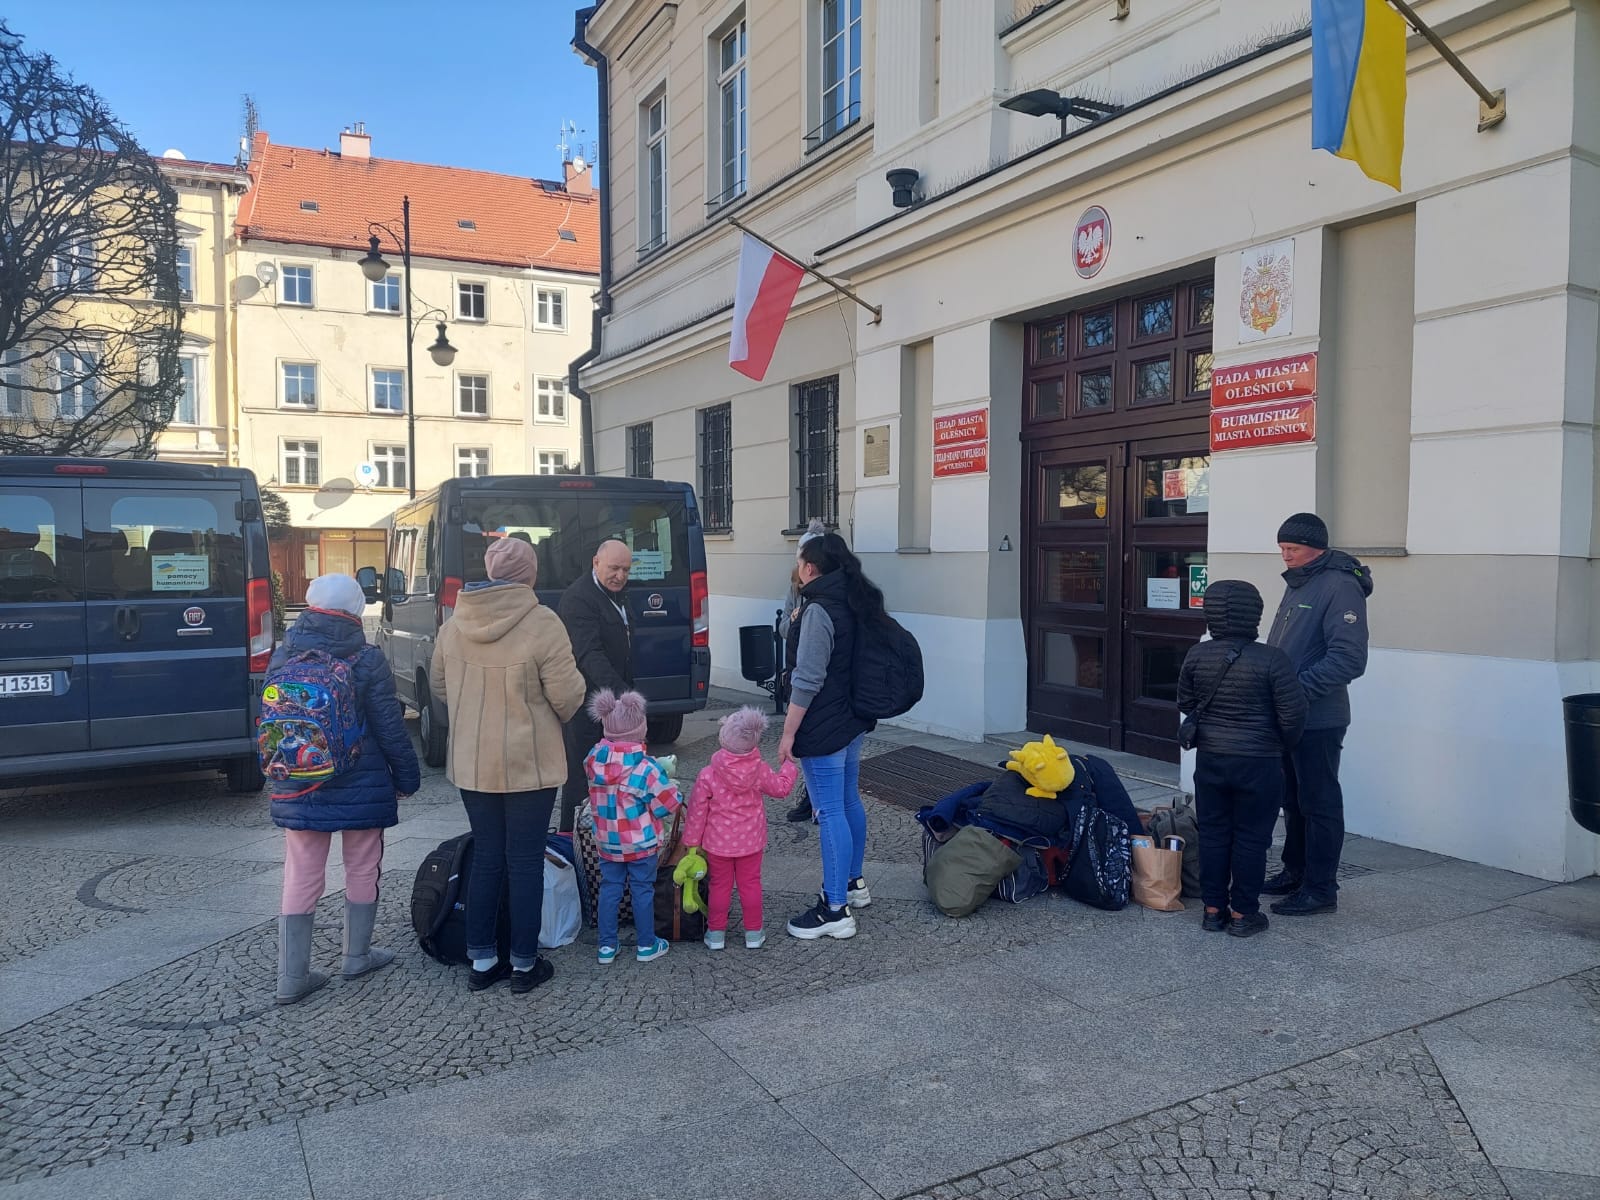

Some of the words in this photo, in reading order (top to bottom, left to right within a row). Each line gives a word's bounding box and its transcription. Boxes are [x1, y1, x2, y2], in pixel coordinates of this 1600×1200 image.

[1215, 371, 1250, 386] RADA
[1255, 362, 1309, 379] MIASTA
[1225, 379, 1296, 400] OLEŚNICY
[935, 420, 956, 430] URZĄD
[958, 415, 984, 426] MIASTA
[1221, 408, 1299, 428] BURMISTRZ
[940, 427, 977, 440] OLEŚNICY
[1214, 430, 1251, 442] MIASTA
[1253, 422, 1308, 437] OLEŚNICY
[188, 612, 202, 621] FIAT
[11, 675, 50, 692] 1313
